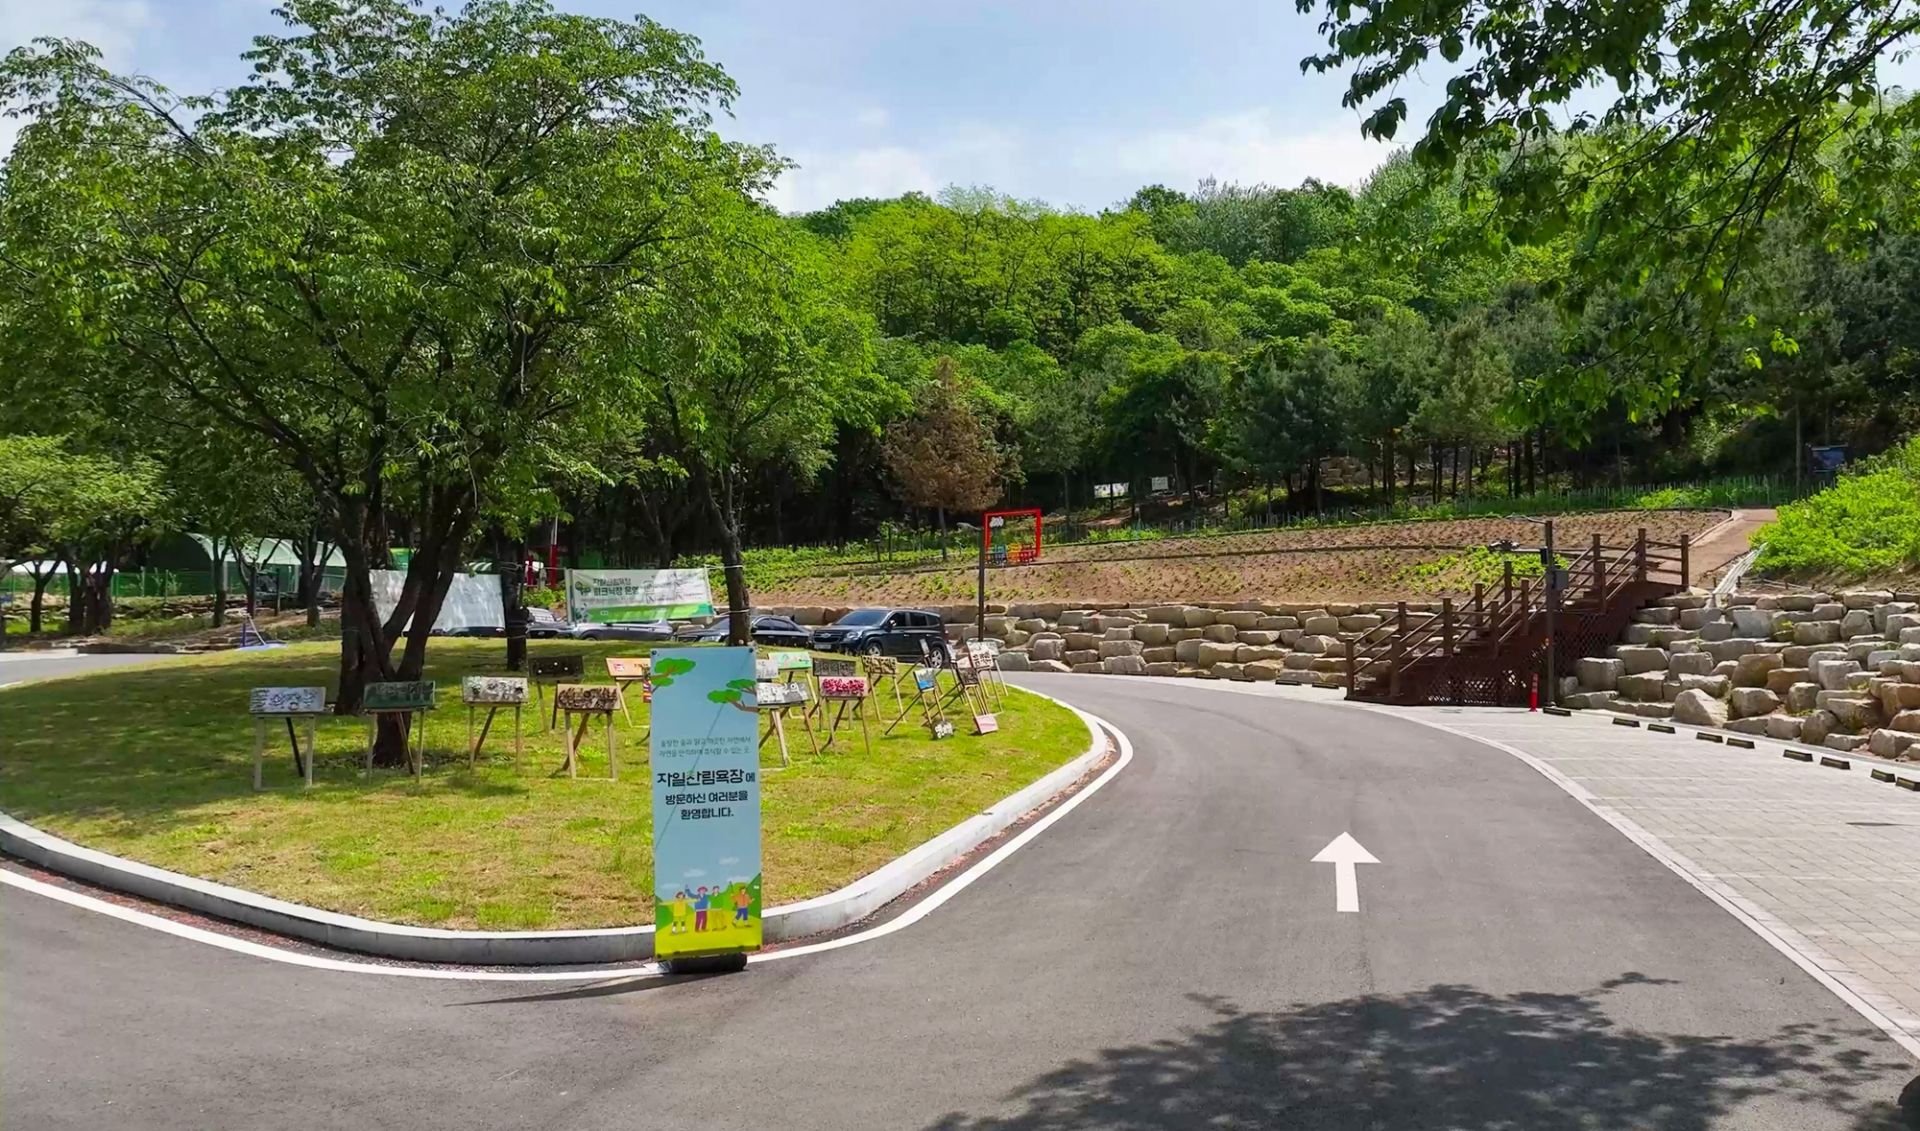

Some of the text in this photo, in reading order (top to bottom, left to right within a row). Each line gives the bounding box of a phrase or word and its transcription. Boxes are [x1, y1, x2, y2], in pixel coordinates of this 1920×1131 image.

[657, 769, 755, 787] 자일산림욕장에
[665, 790, 749, 806] 방문하신 여러분을
[681, 807, 735, 820] 환영합니다.
